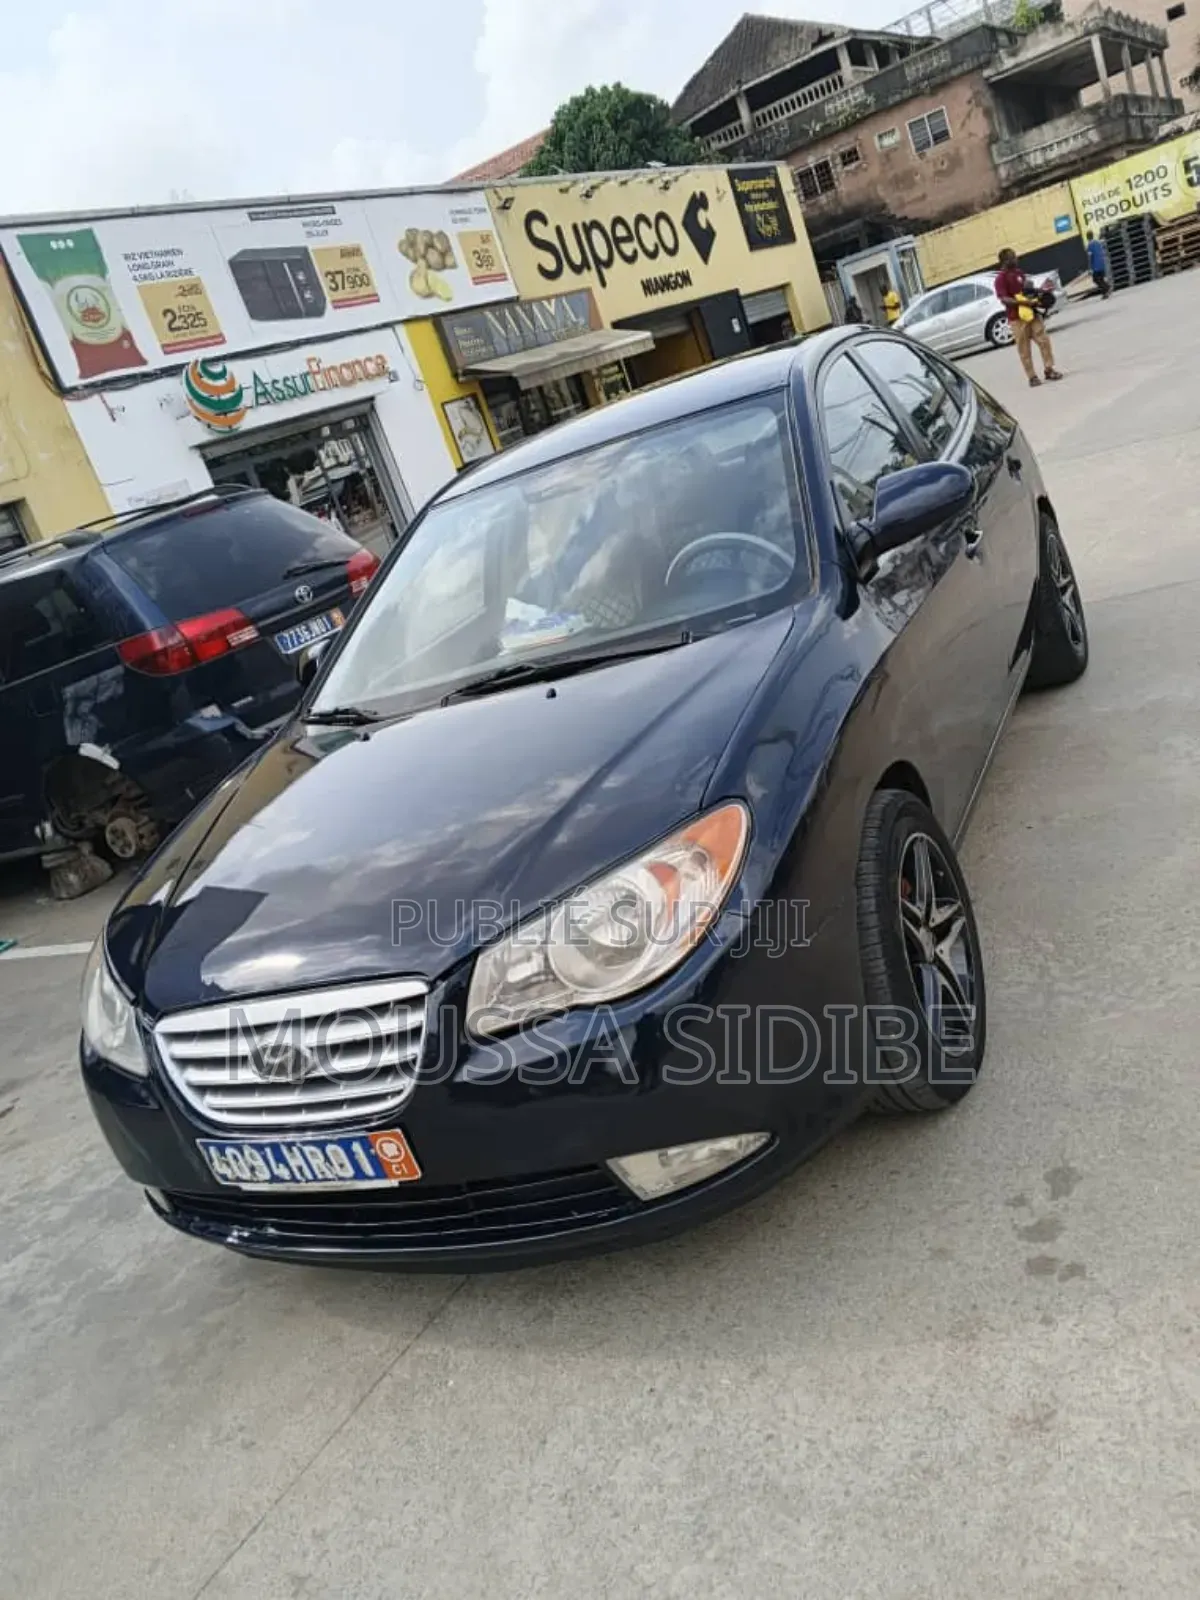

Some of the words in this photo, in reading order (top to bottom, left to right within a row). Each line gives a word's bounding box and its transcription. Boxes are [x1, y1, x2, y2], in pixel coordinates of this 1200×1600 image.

[1081, 193, 1107, 208] PLUS
[1107, 186, 1121, 198] DE
[1125, 164, 1169, 191] 1200
[1083, 182, 1173, 226] PRODUITS
[524, 208, 680, 288] Supeco
[640, 269, 693, 297] NIANGON
[252, 354, 388, 407] AssurFinance
